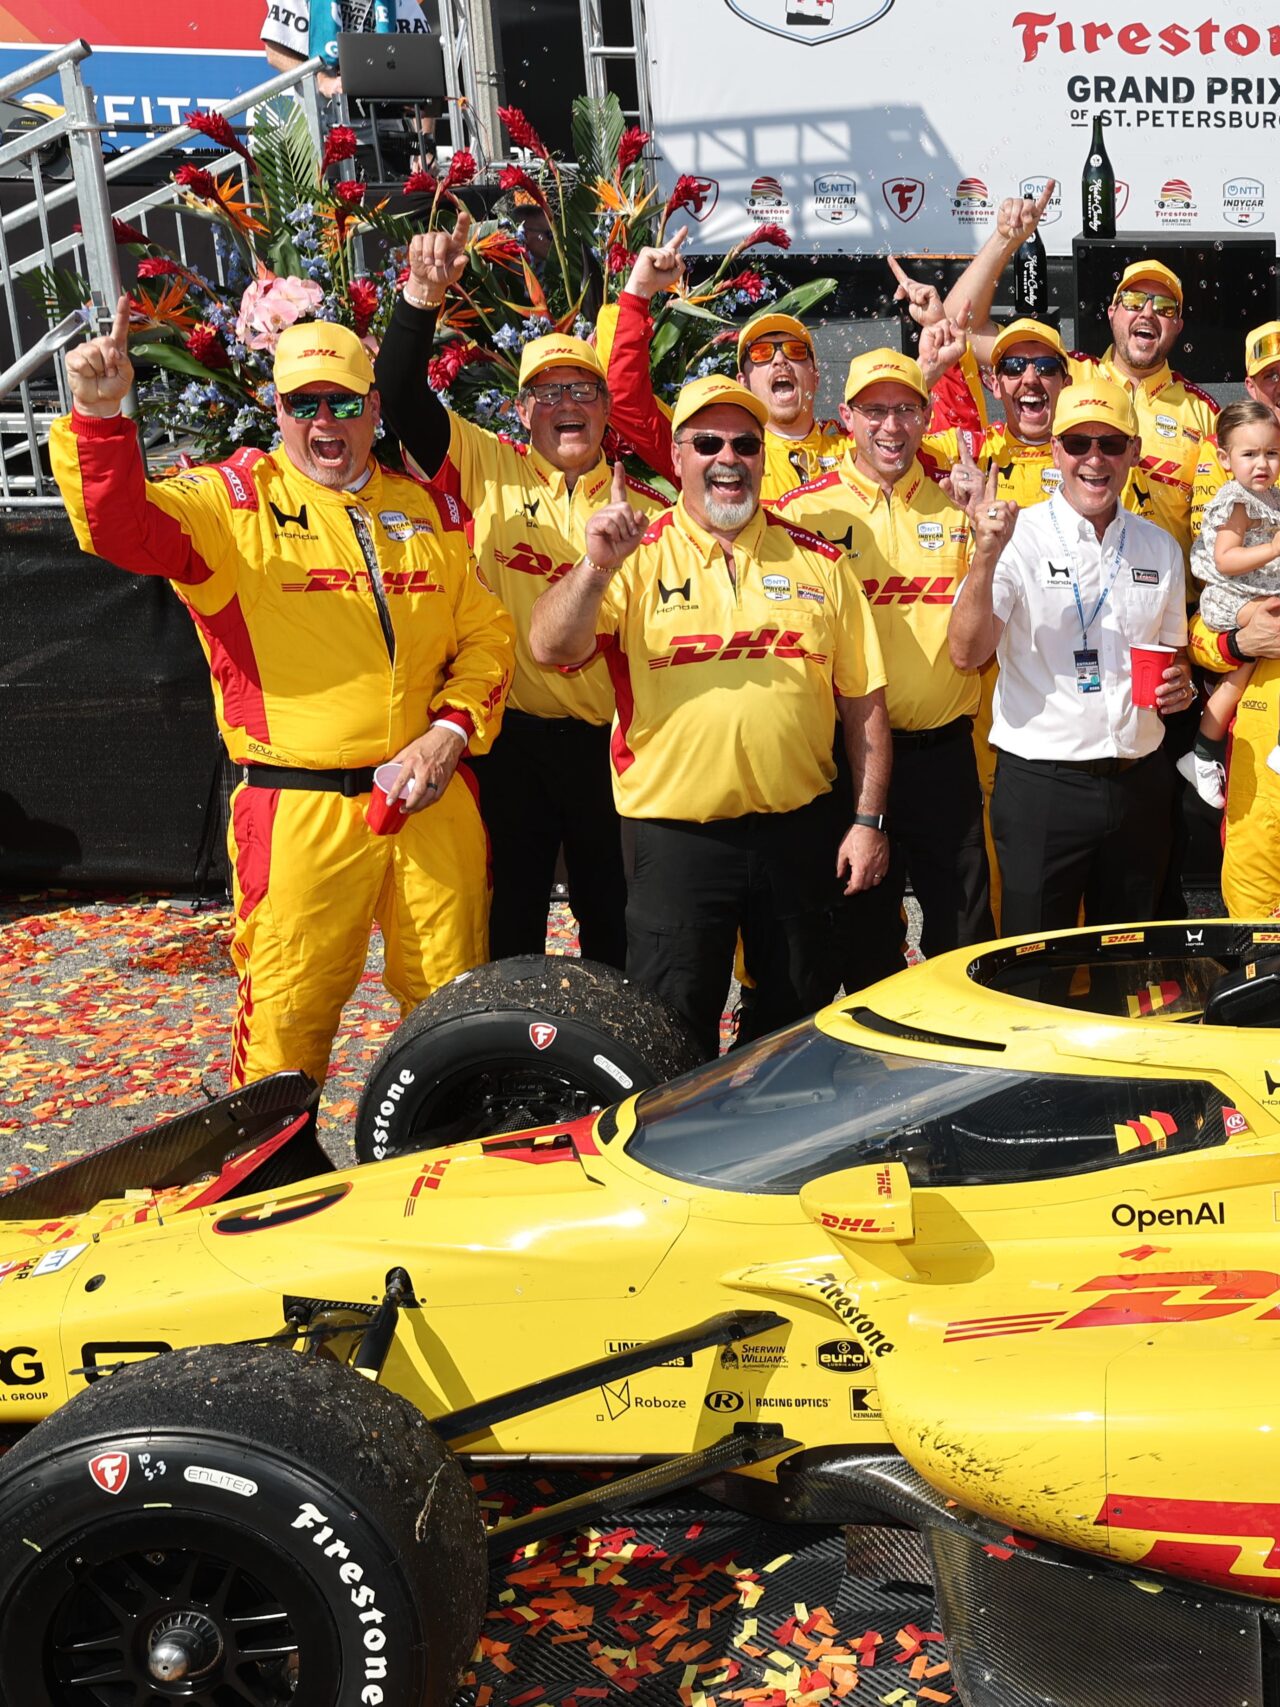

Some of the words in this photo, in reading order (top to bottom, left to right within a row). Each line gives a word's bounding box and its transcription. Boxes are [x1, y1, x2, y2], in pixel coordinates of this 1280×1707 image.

[1067, 75, 1195, 104] GRAND
[1070, 109, 1089, 127] OF
[1101, 109, 1132, 127] ST.
[830, 183, 852, 192] NTT
[1239, 186, 1260, 196] NTT
[815, 196, 857, 205] INDYCAR
[1222, 199, 1264, 208] INDYCAR
[746, 208, 791, 217] Firestone
[951, 209, 995, 217] Firestone
[299, 348, 343, 360] DHL
[873, 363, 903, 372] DHL
[1079, 399, 1109, 407] DHL
[220, 465, 248, 502] sparco
[589, 478, 607, 498] DHL
[626, 478, 673, 505] Firestone
[780, 477, 829, 504] Firestone
[905, 478, 921, 504] DHL
[1196, 485, 1217, 496] PNC
[274, 531, 319, 541] Honda
[785, 528, 836, 553] Firestone
[302, 568, 440, 594] DHL
[656, 603, 699, 616] Honda
[669, 629, 812, 666] DHL
[1106, 934, 1138, 944] DHL
[820, 1211, 882, 1234] DHL
[1111, 1201, 1225, 1233] OpenAI
[807, 1272, 896, 1358] Firestone
[741, 1343, 786, 1354] SHERWIN
[820, 1353, 869, 1364] eurol
[11, 1392, 49, 1401] GROUP
[634, 1396, 687, 1409] Roboze
[755, 1397, 793, 1408] RACING
[794, 1397, 830, 1408] OPTICS
[290, 1501, 391, 1706] Firestone
